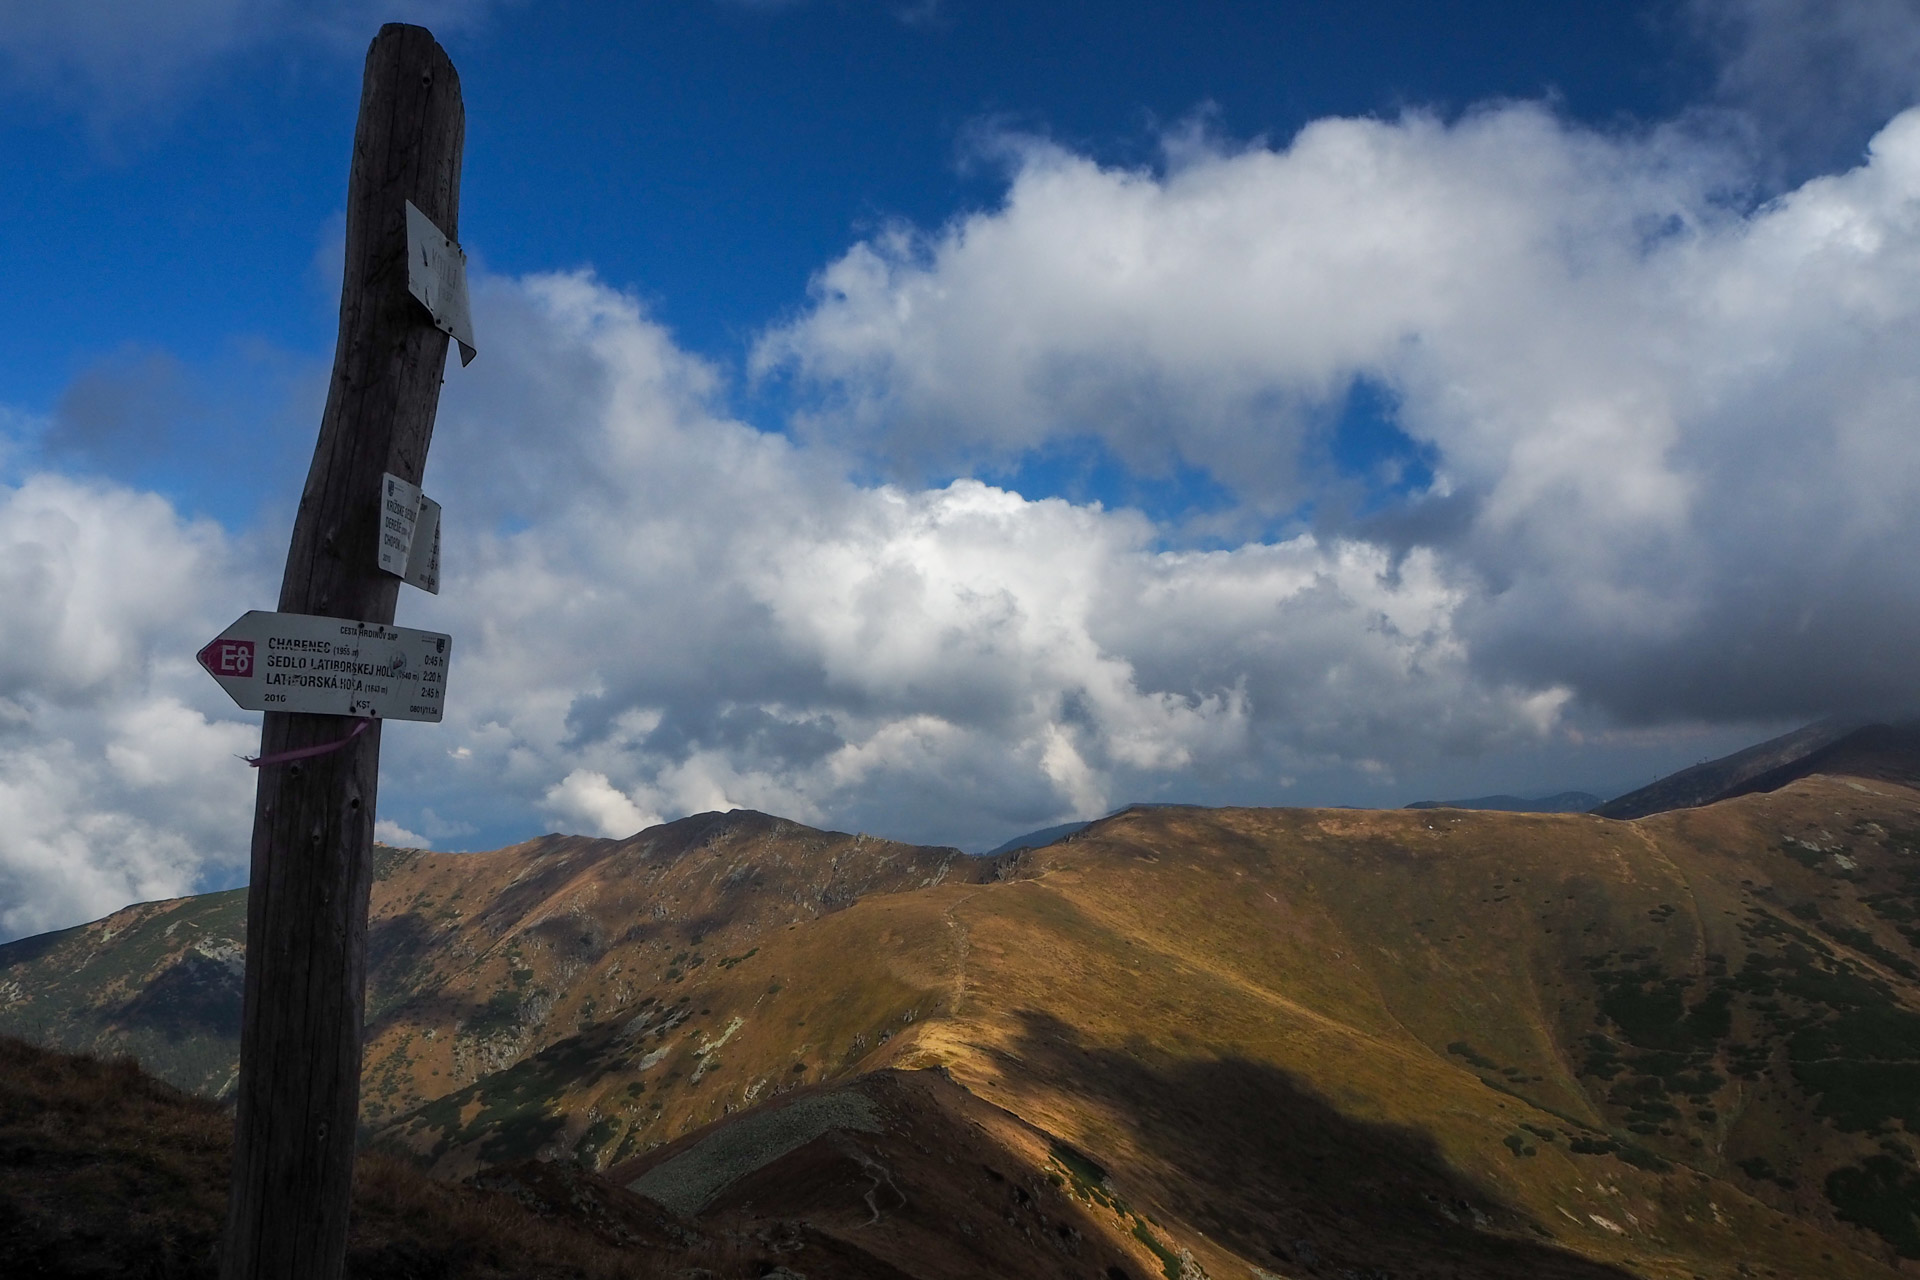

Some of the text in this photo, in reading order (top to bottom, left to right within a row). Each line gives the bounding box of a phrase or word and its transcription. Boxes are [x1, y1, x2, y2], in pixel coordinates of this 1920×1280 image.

[340, 626, 357, 636] CESTA
[388, 632, 398, 641] SNP
[220, 644, 249, 672] E8
[424, 654, 444, 667] 0:45 h
[267, 655, 306, 668] SEDLO
[311, 658, 374, 675] LATIBORSKEJ
[423, 671, 442, 683] 2:20 h
[421, 687, 440, 699] 2:45 h
[356, 700, 370, 709] KST
